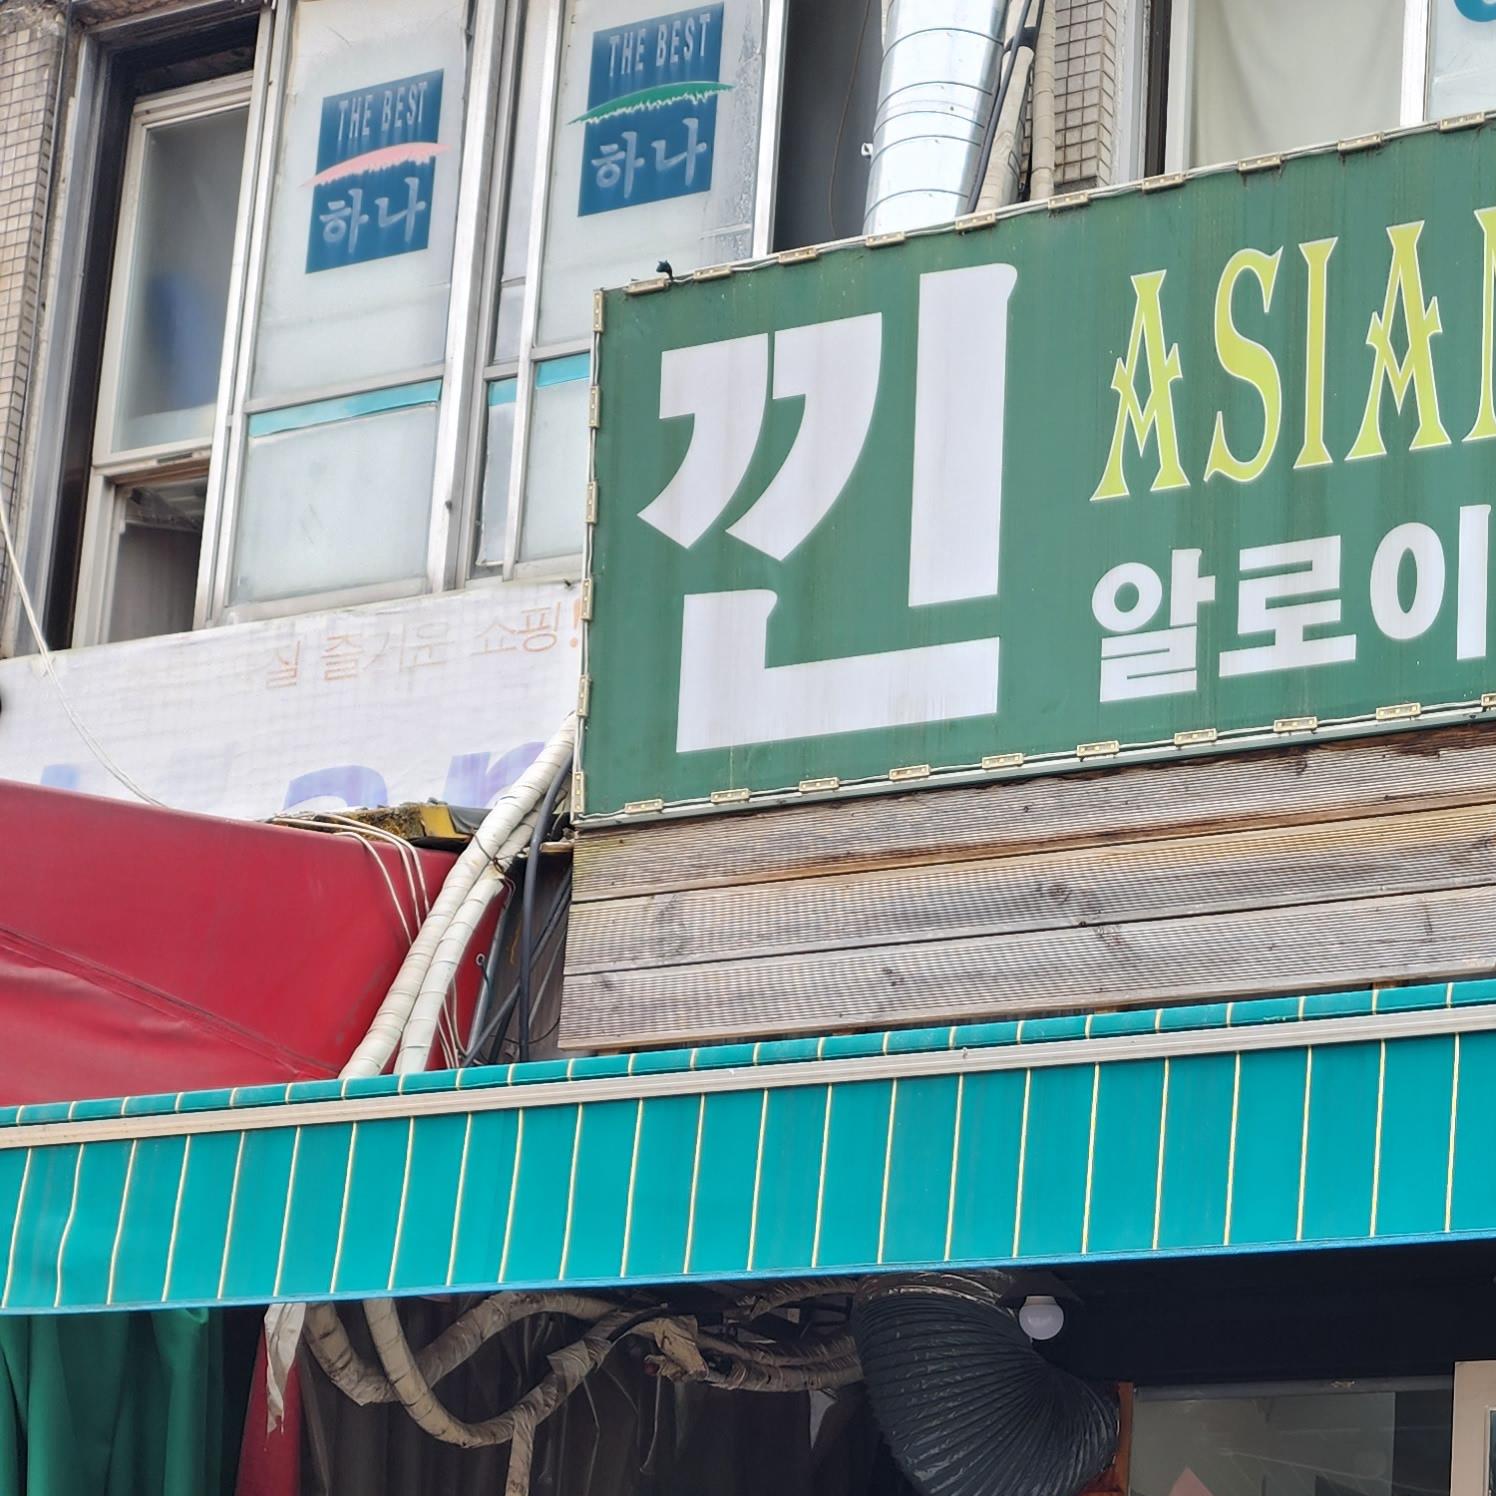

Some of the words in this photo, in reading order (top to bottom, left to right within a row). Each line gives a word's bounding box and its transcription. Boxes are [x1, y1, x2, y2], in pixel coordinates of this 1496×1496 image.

[608, 30, 645, 77] THE
[655, 13, 712, 65] BEST
[337, 94, 371, 141] THE
[382, 82, 428, 127] BEST
[591, 117, 707, 199] 하나
[319, 177, 426, 254] 하나
[637, 263, 1018, 753] 낀
[1091, 503, 1491, 703] 알로이
